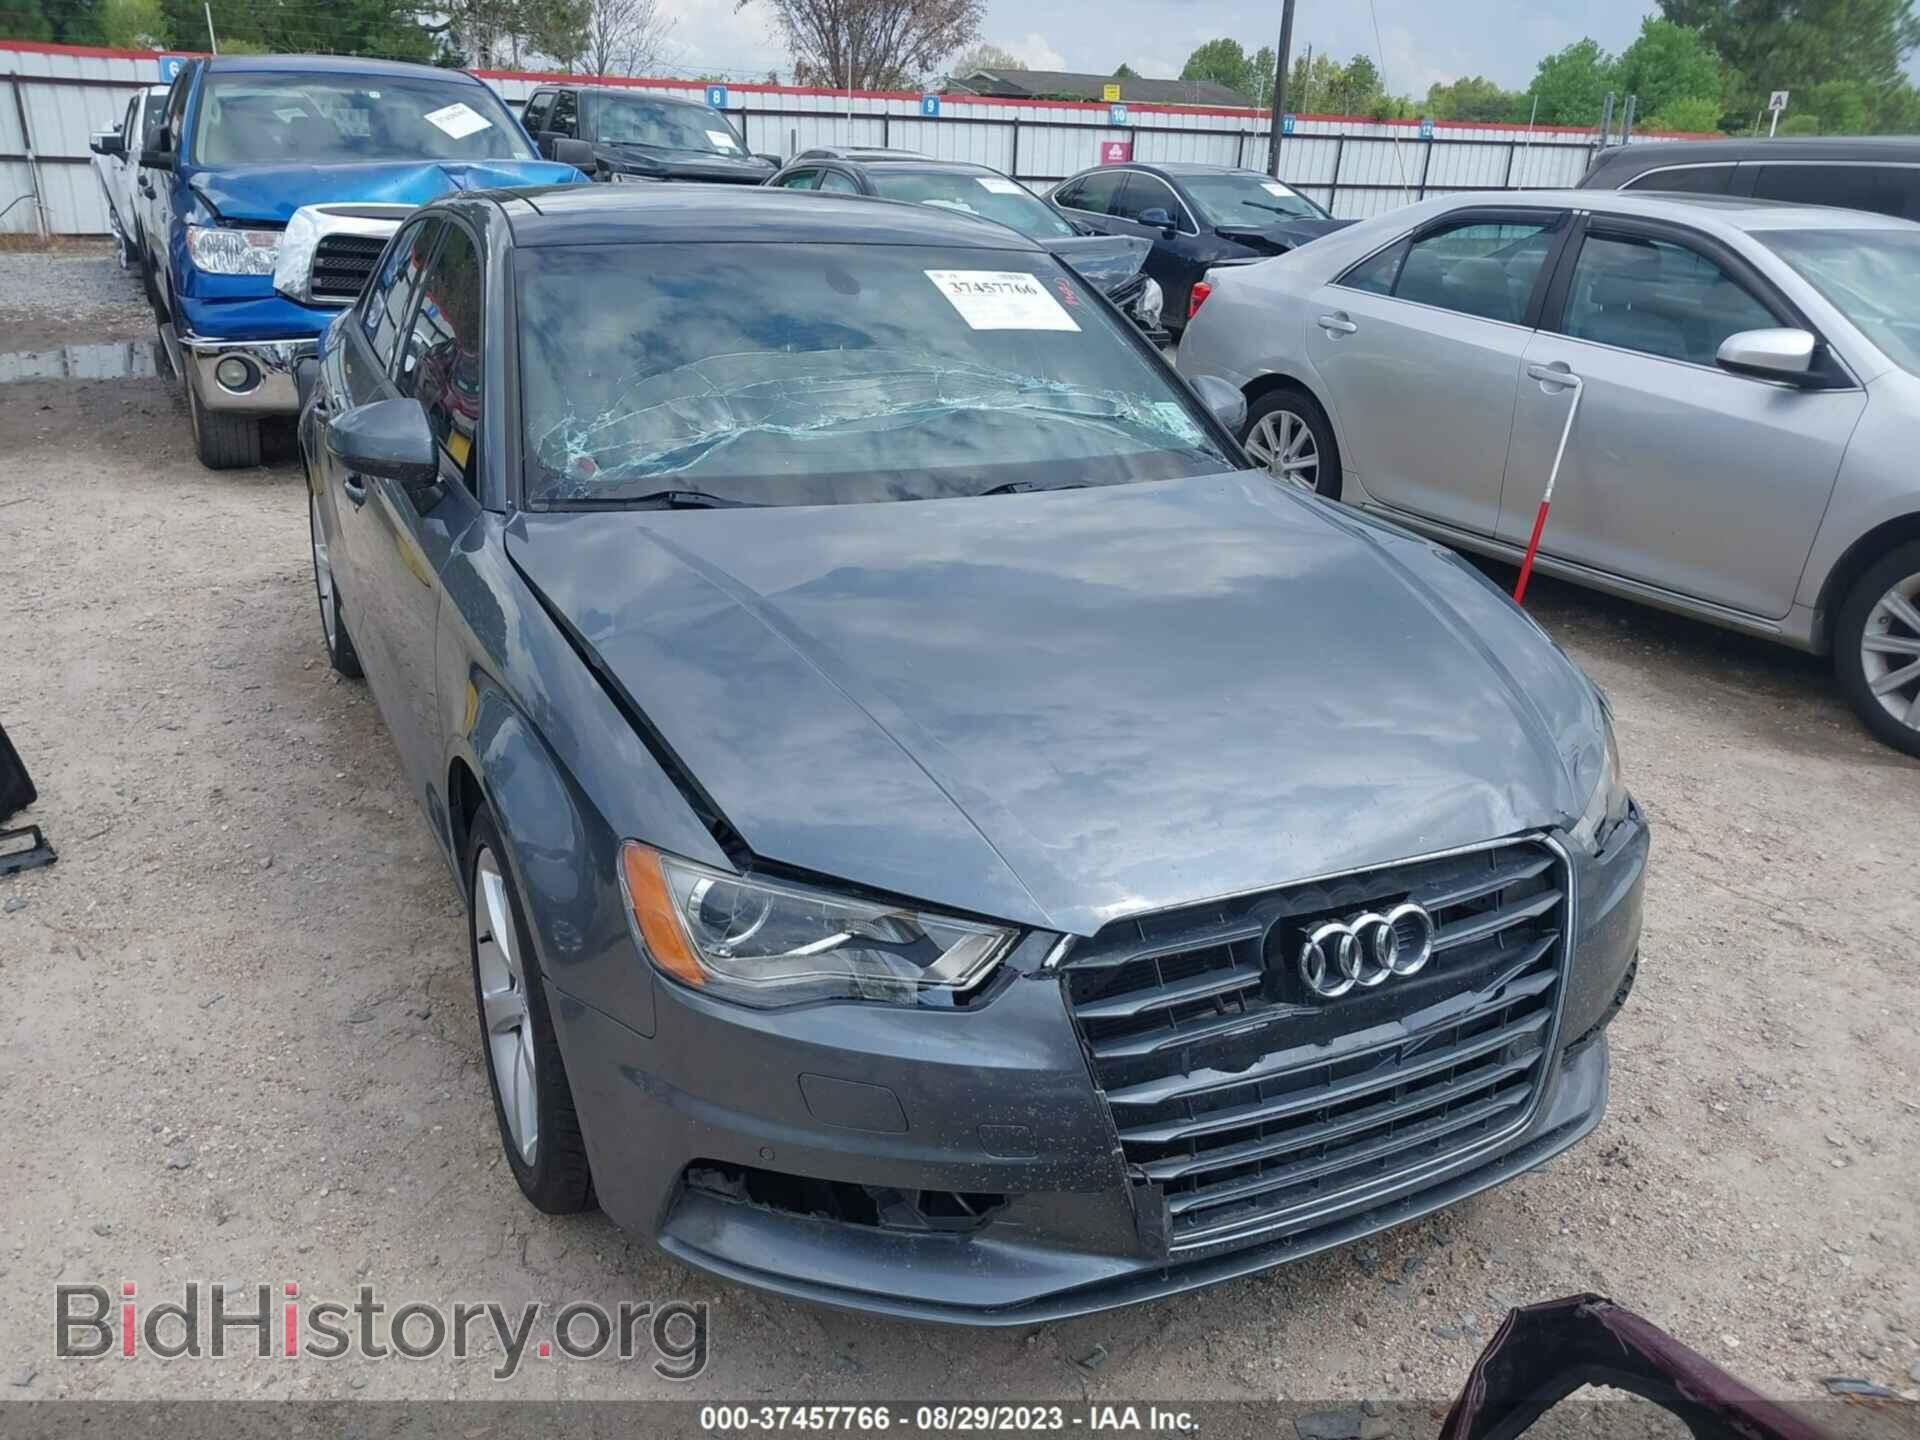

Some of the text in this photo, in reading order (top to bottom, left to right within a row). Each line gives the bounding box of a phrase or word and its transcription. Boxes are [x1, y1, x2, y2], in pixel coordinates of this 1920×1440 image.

[712, 90, 721, 105] 8
[1772, 95, 1783, 106] A
[926, 99, 935, 113] 9
[1114, 108, 1126, 121] 10
[1283, 118, 1294, 131] 11
[949, 281, 1038, 296] 37457766
